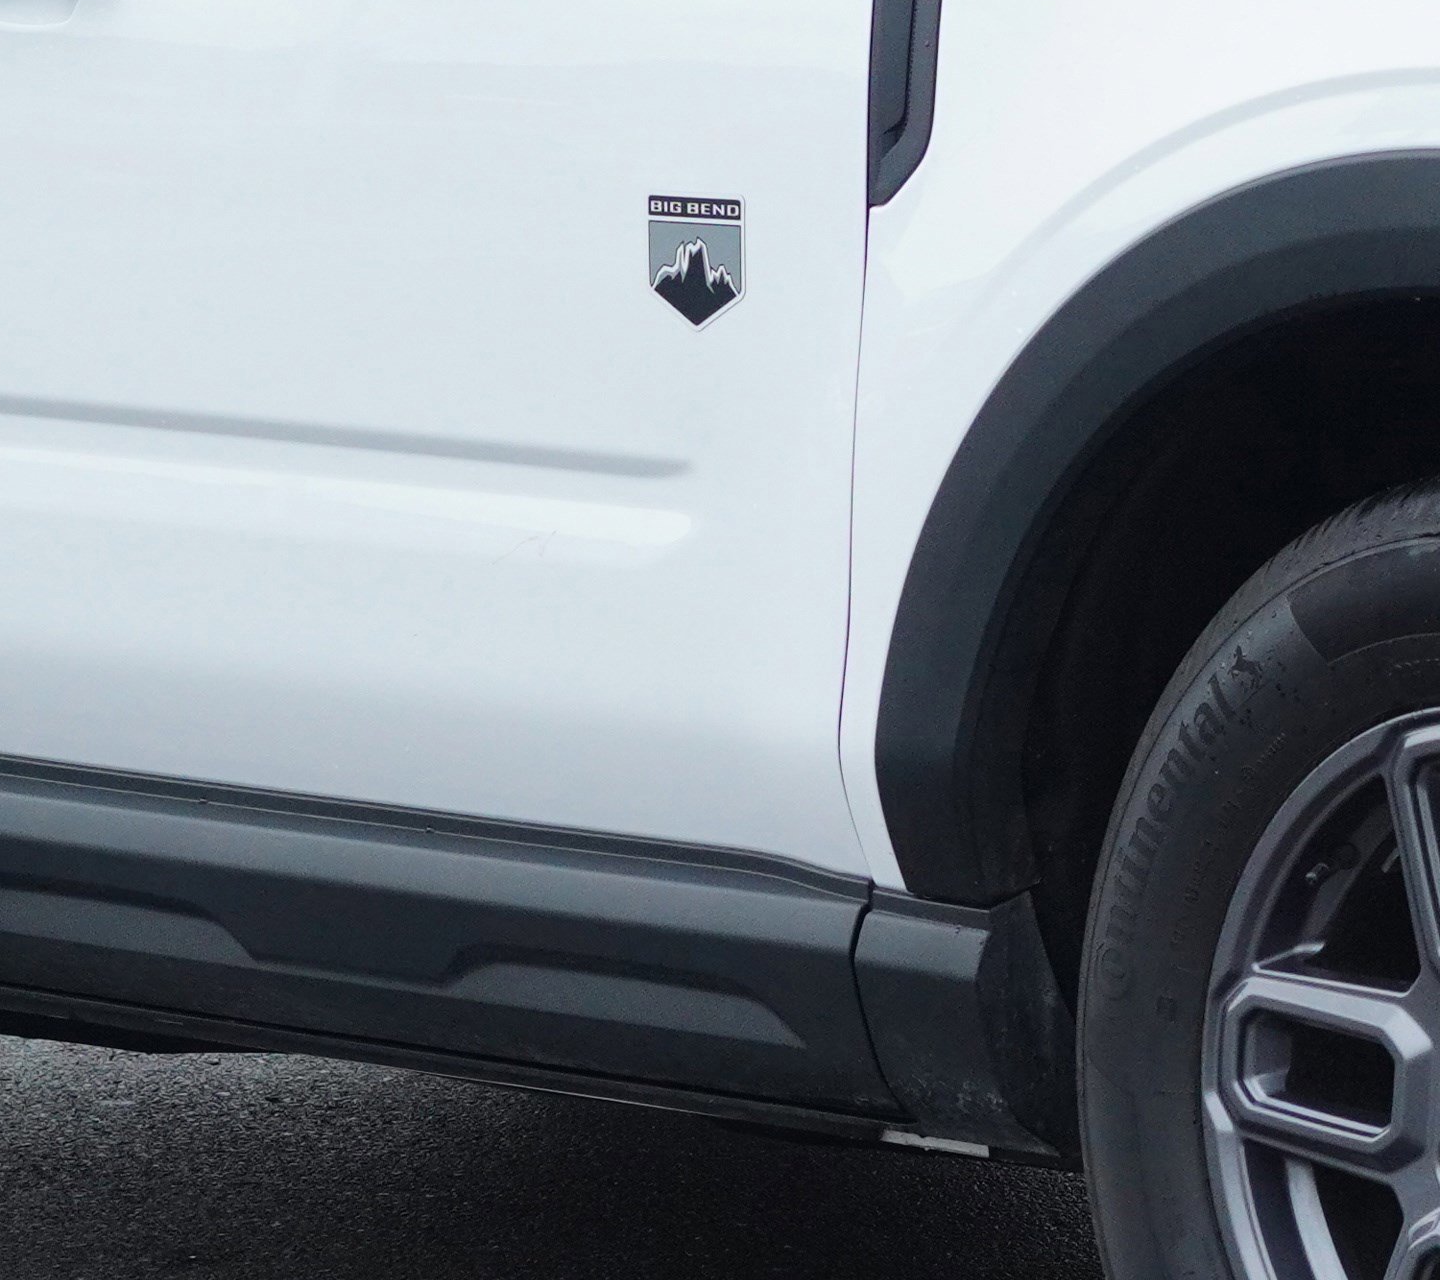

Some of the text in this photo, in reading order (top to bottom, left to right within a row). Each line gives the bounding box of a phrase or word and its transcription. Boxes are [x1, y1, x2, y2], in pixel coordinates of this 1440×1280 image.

[649, 200, 741, 218] BIG BEND
[1097, 673, 1238, 1003] Continental
